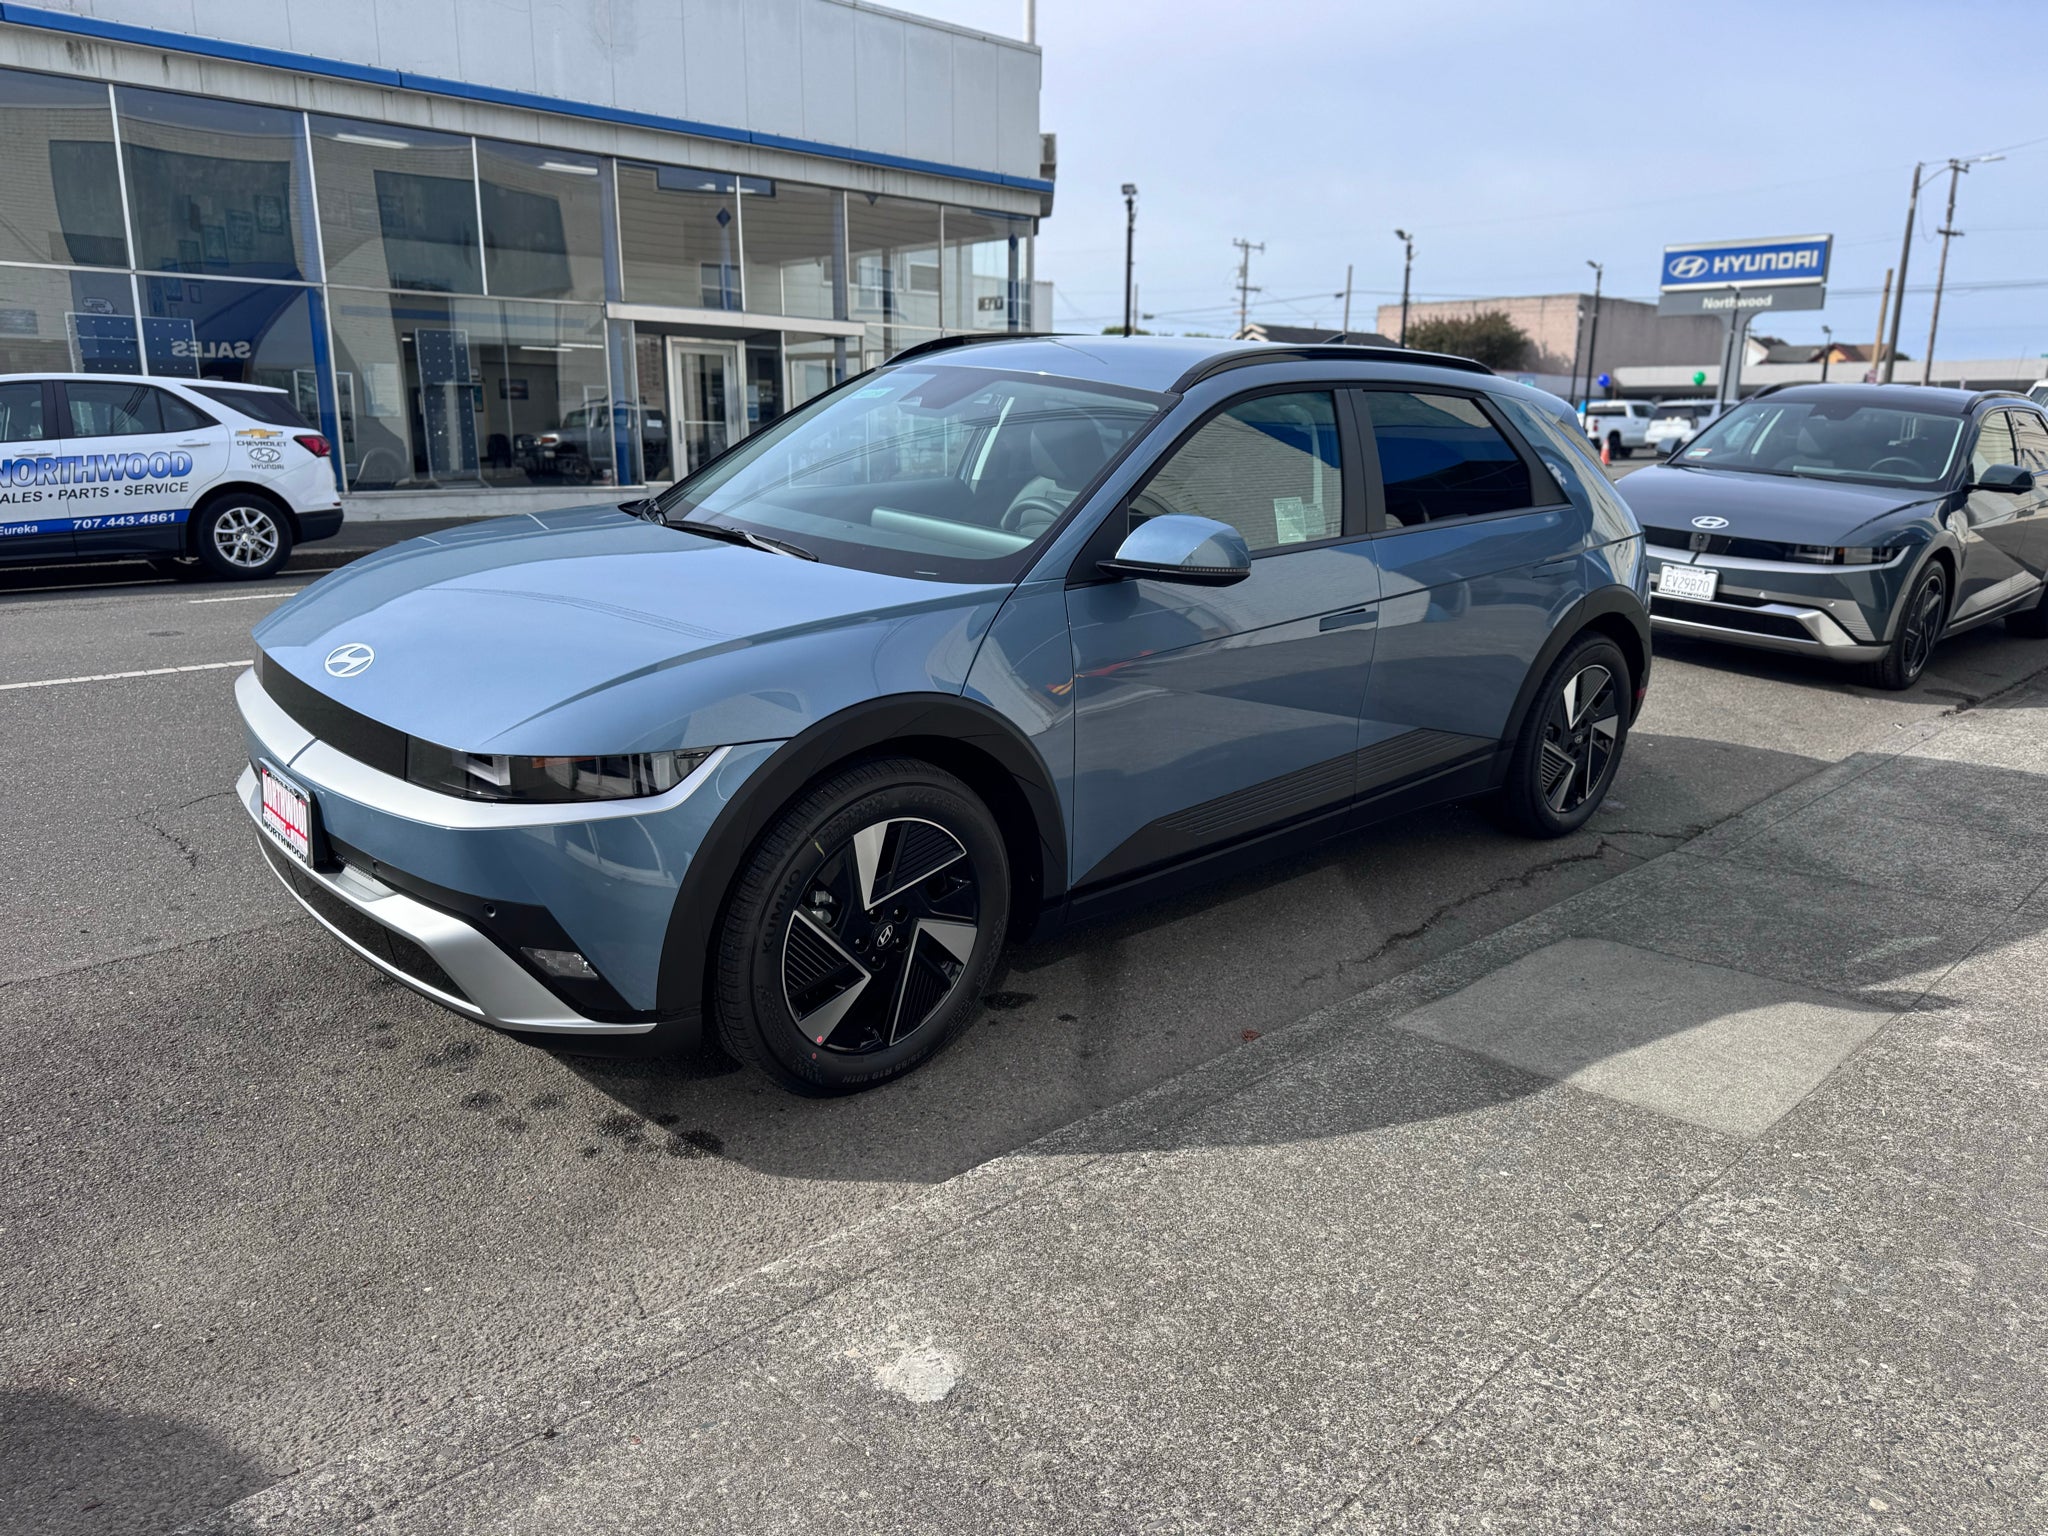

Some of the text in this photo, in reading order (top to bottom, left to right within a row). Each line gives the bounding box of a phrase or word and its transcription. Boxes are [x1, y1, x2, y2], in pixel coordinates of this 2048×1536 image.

[1712, 250, 1819, 274] HYUNDAI
[1702, 294, 1773, 309] Northwood
[236, 440, 287, 448] CHEVROLET
[0, 450, 193, 488] NORTHWOOD
[58, 486, 110, 500] PARTS
[124, 481, 189, 496] SERVICE
[0, 511, 176, 536] Eureka 707.443.4861
[263, 818, 307, 864] NORTHWOOD
[761, 868, 801, 954] KUMHO
